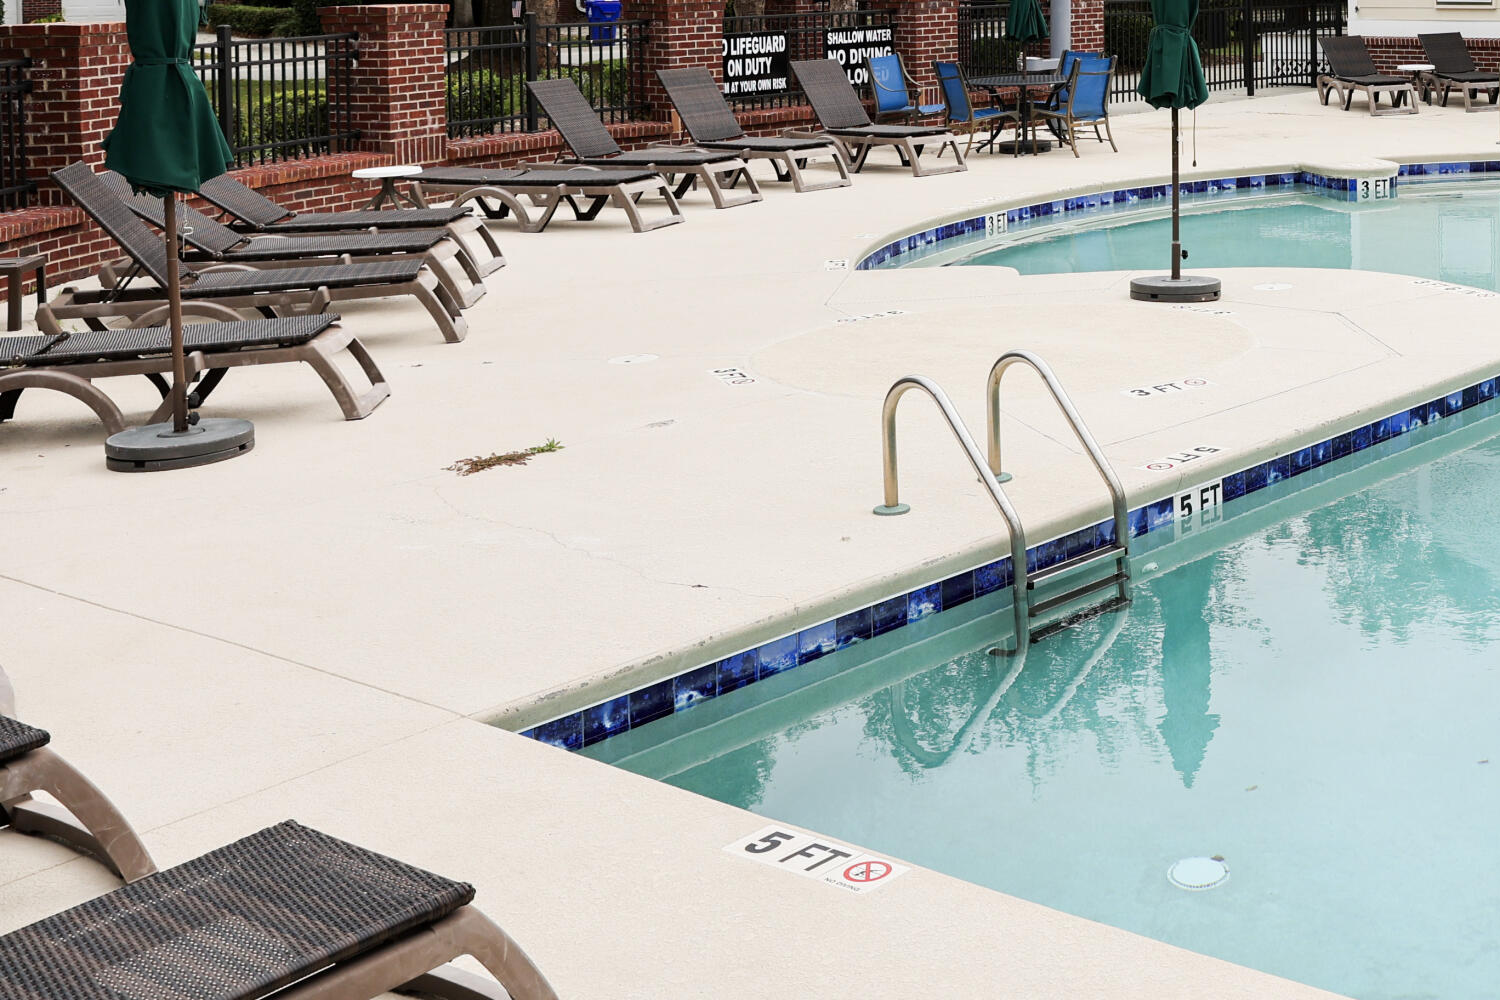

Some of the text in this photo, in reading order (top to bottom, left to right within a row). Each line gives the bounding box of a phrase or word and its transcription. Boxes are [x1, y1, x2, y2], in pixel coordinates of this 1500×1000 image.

[730, 35, 786, 56] LIFEGUARD
[827, 28, 892, 45] SHALLOW WATER
[827, 46, 892, 65] NO DIVING
[727, 56, 772, 77] ON DUTY
[731, 81, 739, 93] AT
[740, 80, 757, 93] YOUR
[757, 79, 772, 91] OWN
[773, 77, 787, 89] RISK
[1130, 382, 1183, 397] 3 FT
[1180, 483, 1221, 518] 5 FT
[744, 831, 853, 872] 5 FT
